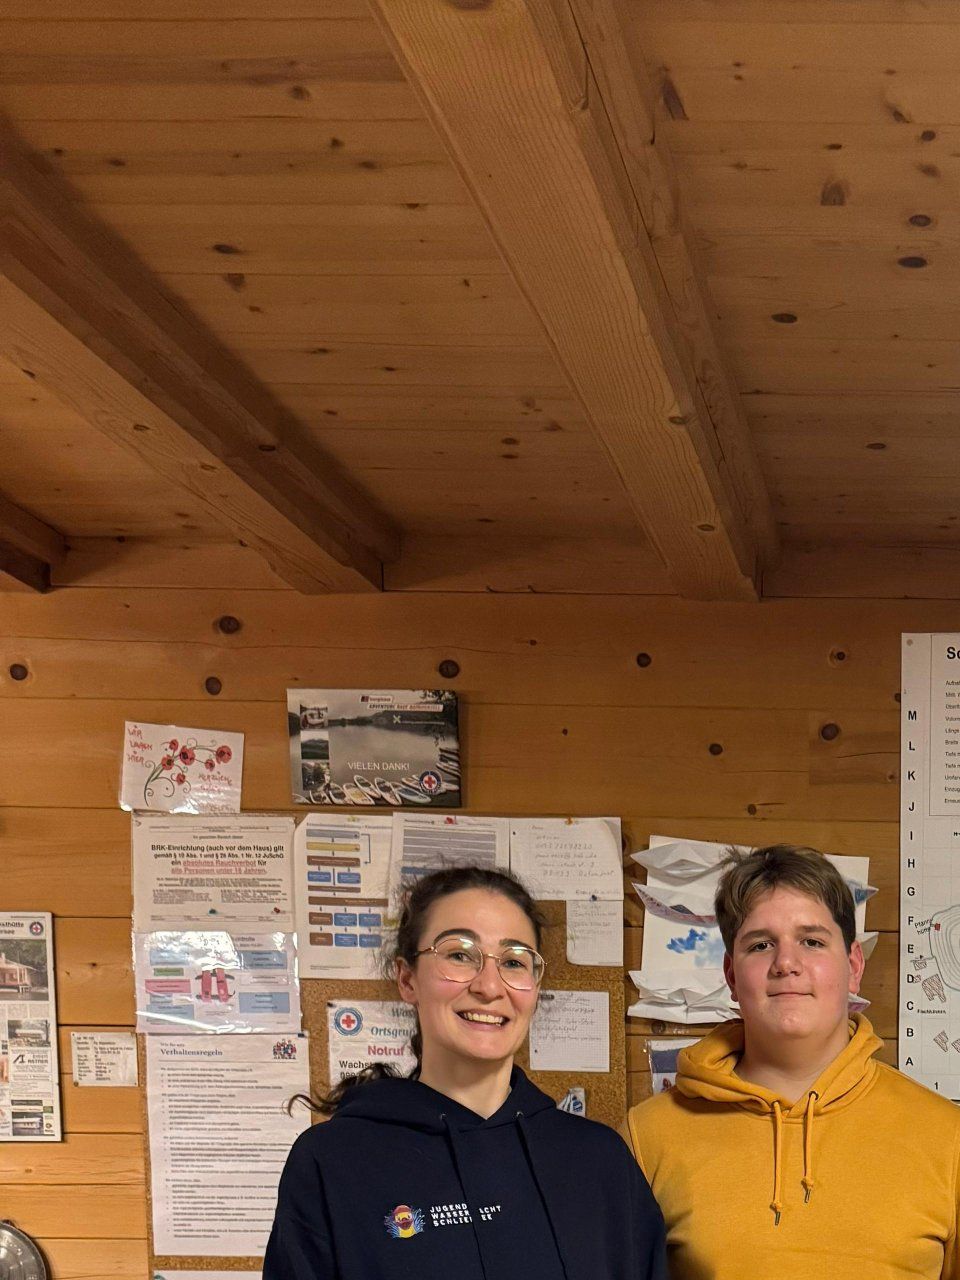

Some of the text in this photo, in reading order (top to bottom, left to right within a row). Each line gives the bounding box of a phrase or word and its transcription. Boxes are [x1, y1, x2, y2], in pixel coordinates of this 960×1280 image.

[908, 710, 917, 721] M
[908, 740, 916, 751] L
[348, 762, 410, 771] VIELEN DANK!
[907, 770, 916, 781] K
[908, 801, 915, 812] J
[151, 844, 205, 852] BRK-Einrichtung
[206, 844, 224, 852] (auch
[907, 858, 915, 869] H
[906, 886, 916, 897] G
[907, 915, 915, 927] F
[907, 943, 915, 954] E
[906, 973, 914, 984] D
[906, 1000, 914, 1011] C
[906, 1027, 914, 1038] B
[160, 1048, 223, 1057] Verhaltensregeln
[368, 1046, 404, 1056] Notruf
[905, 1056, 914, 1066] A
[430, 1203, 468, 1213] JUGEND
